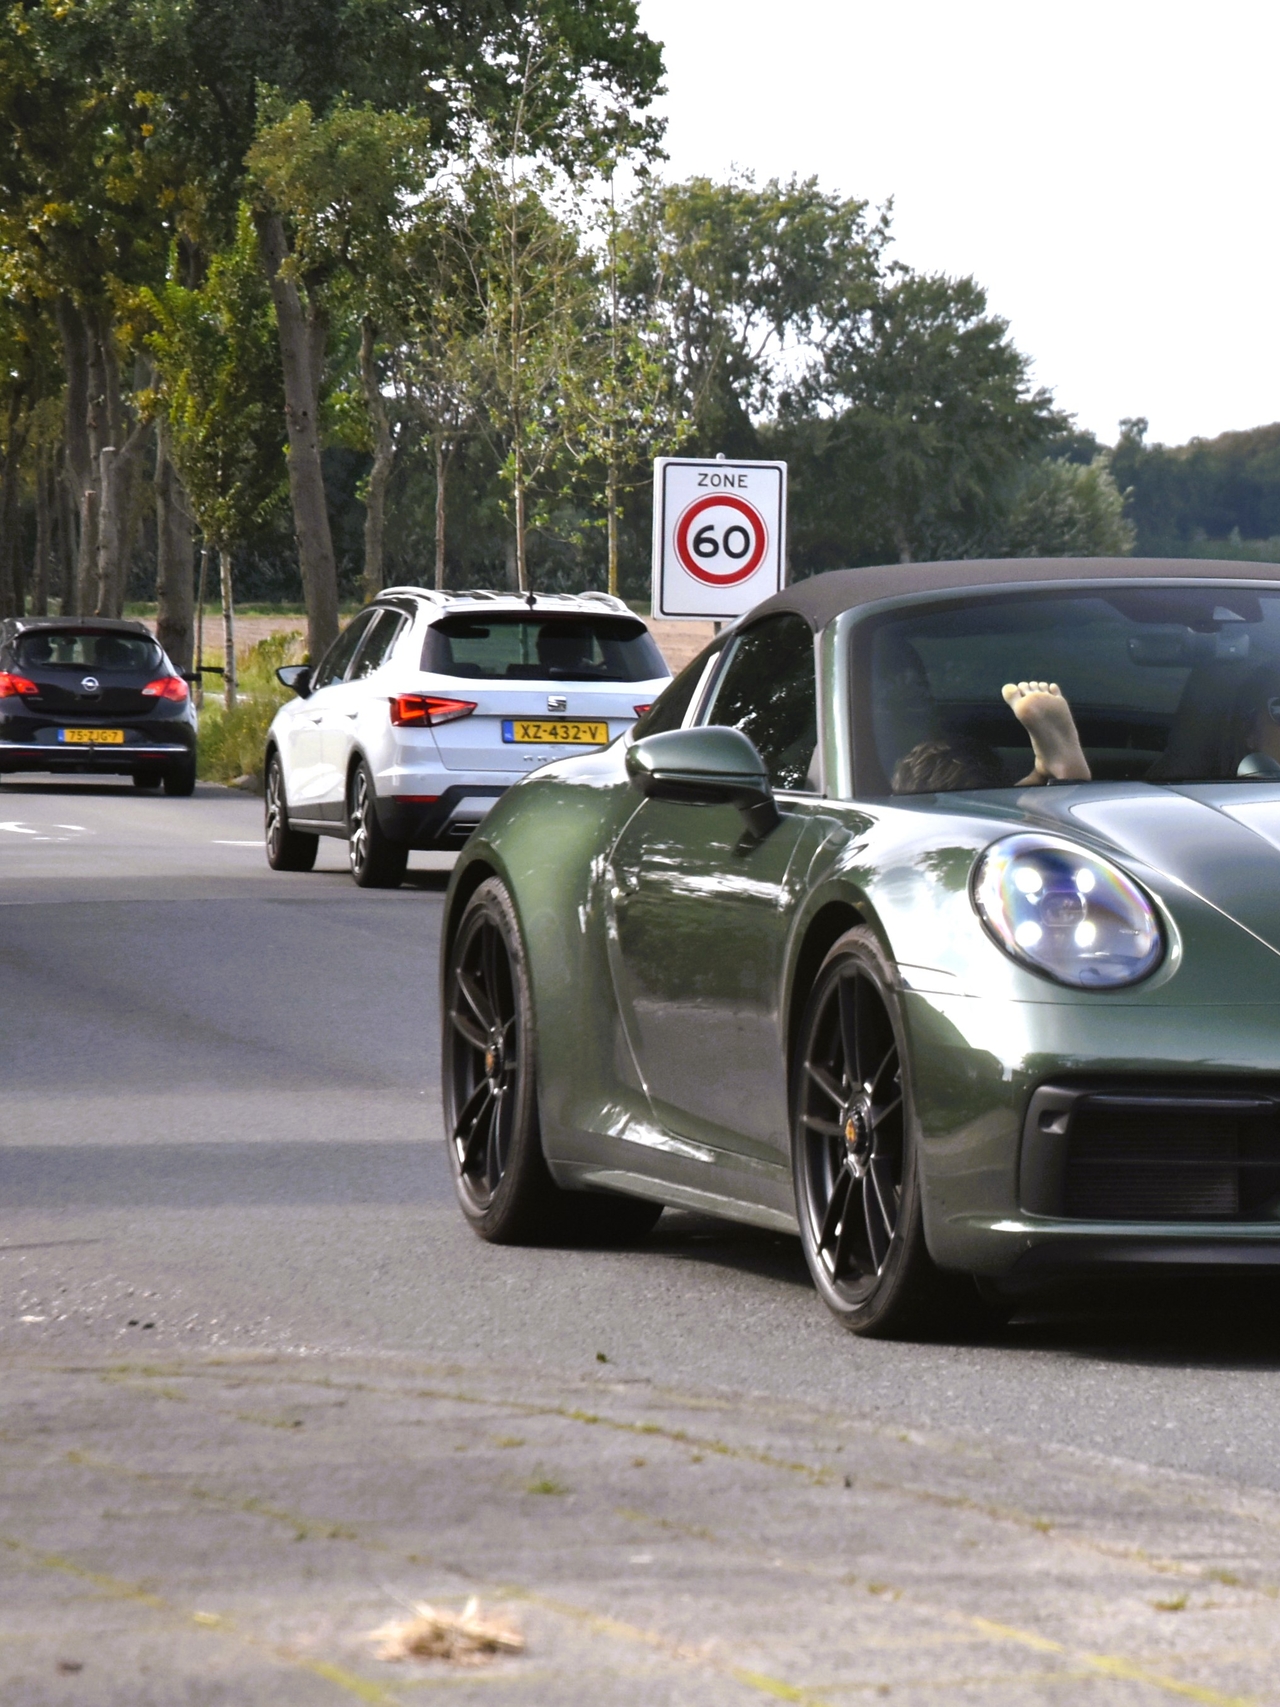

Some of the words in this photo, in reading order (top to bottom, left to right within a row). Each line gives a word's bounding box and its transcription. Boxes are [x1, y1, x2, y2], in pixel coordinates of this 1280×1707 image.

[697, 473, 748, 488] ZONE
[693, 524, 751, 560] 60
[520, 724, 599, 740] XZ-432-V
